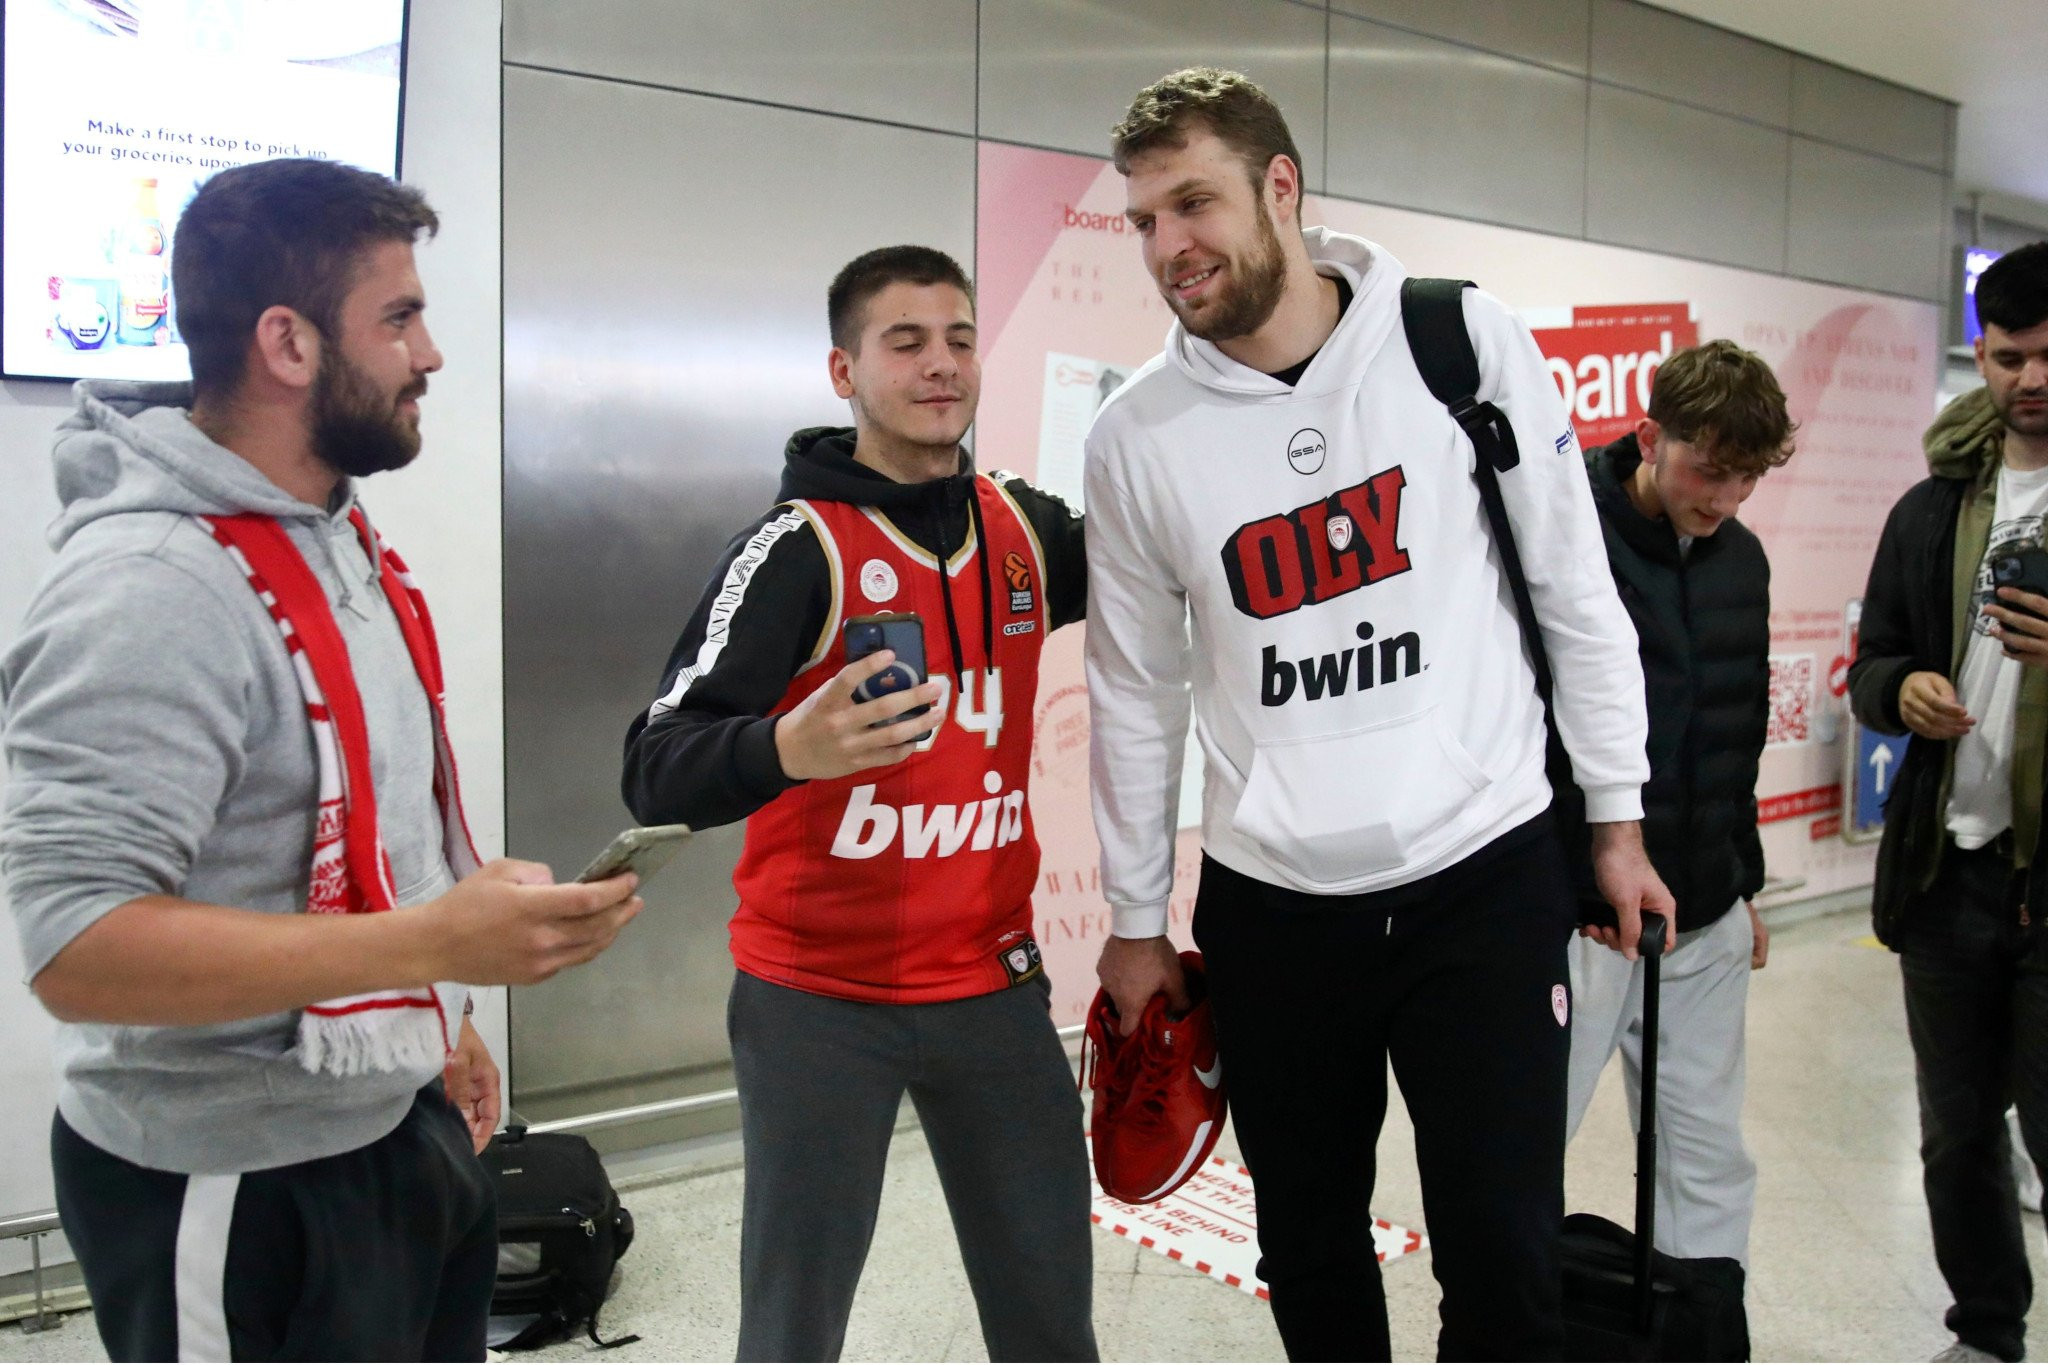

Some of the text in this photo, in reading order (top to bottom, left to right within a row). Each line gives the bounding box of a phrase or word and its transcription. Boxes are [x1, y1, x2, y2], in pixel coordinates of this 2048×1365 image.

[63, 142, 102, 155] your
[111, 148, 193, 165] groceries
[88, 119, 134, 137] Make
[142, 129, 151, 139] a
[158, 128, 192, 144] first
[200, 135, 238, 151] stop
[245, 140, 261, 151] to
[268, 143, 300, 156] pick
[1291, 444, 1323, 458] GSA
[1221, 464, 1412, 620] OLY
[709, 576, 742, 645] ARMANI
[1261, 621, 1421, 707] bwin
[830, 771, 1025, 859] bwin
[1138, 1214, 1194, 1237] LINE
[1166, 1208, 1249, 1244] BEHIND
